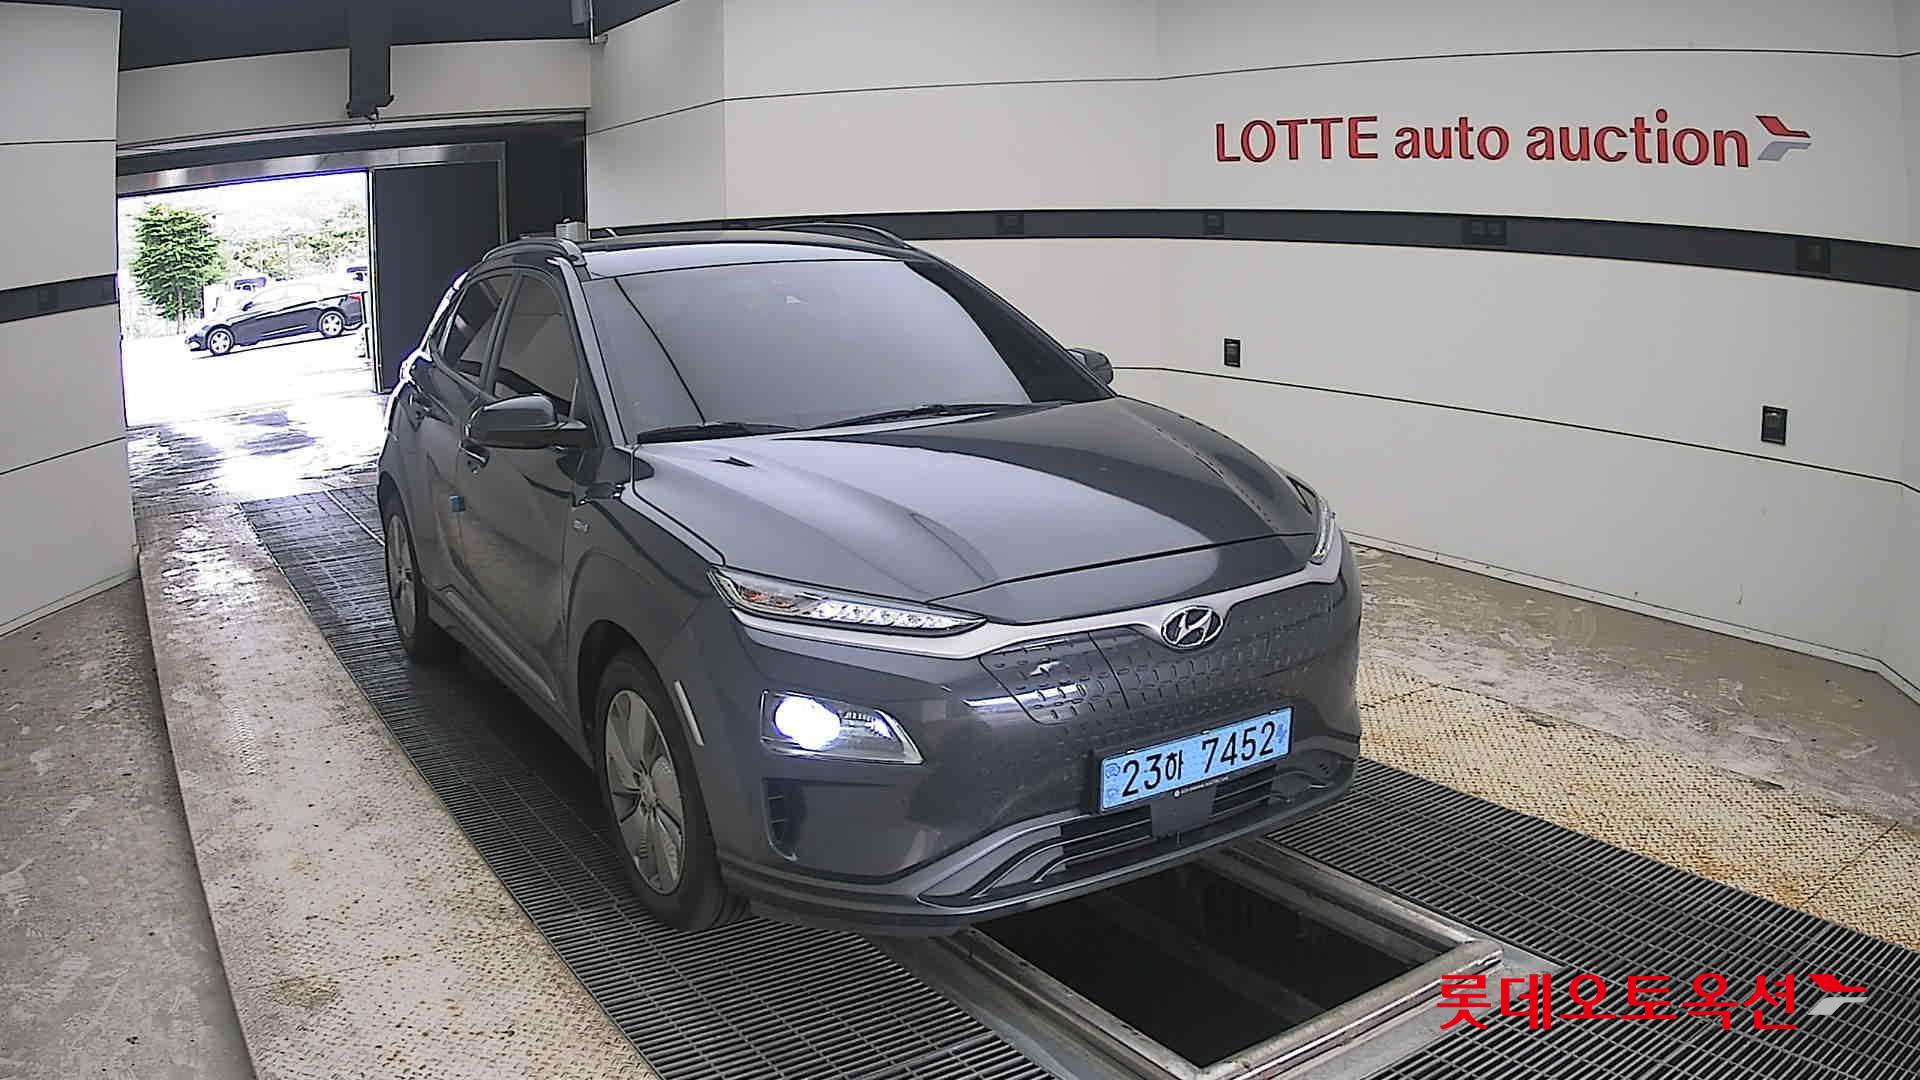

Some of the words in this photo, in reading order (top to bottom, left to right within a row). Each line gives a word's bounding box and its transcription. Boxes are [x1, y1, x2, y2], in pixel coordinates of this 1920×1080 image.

[1215, 115, 1378, 162] LOTTE
[1394, 116, 1509, 161] auto
[1525, 108, 1750, 168] auction
[1122, 749, 1184, 797] 23하
[1201, 721, 1276, 774] 7452
